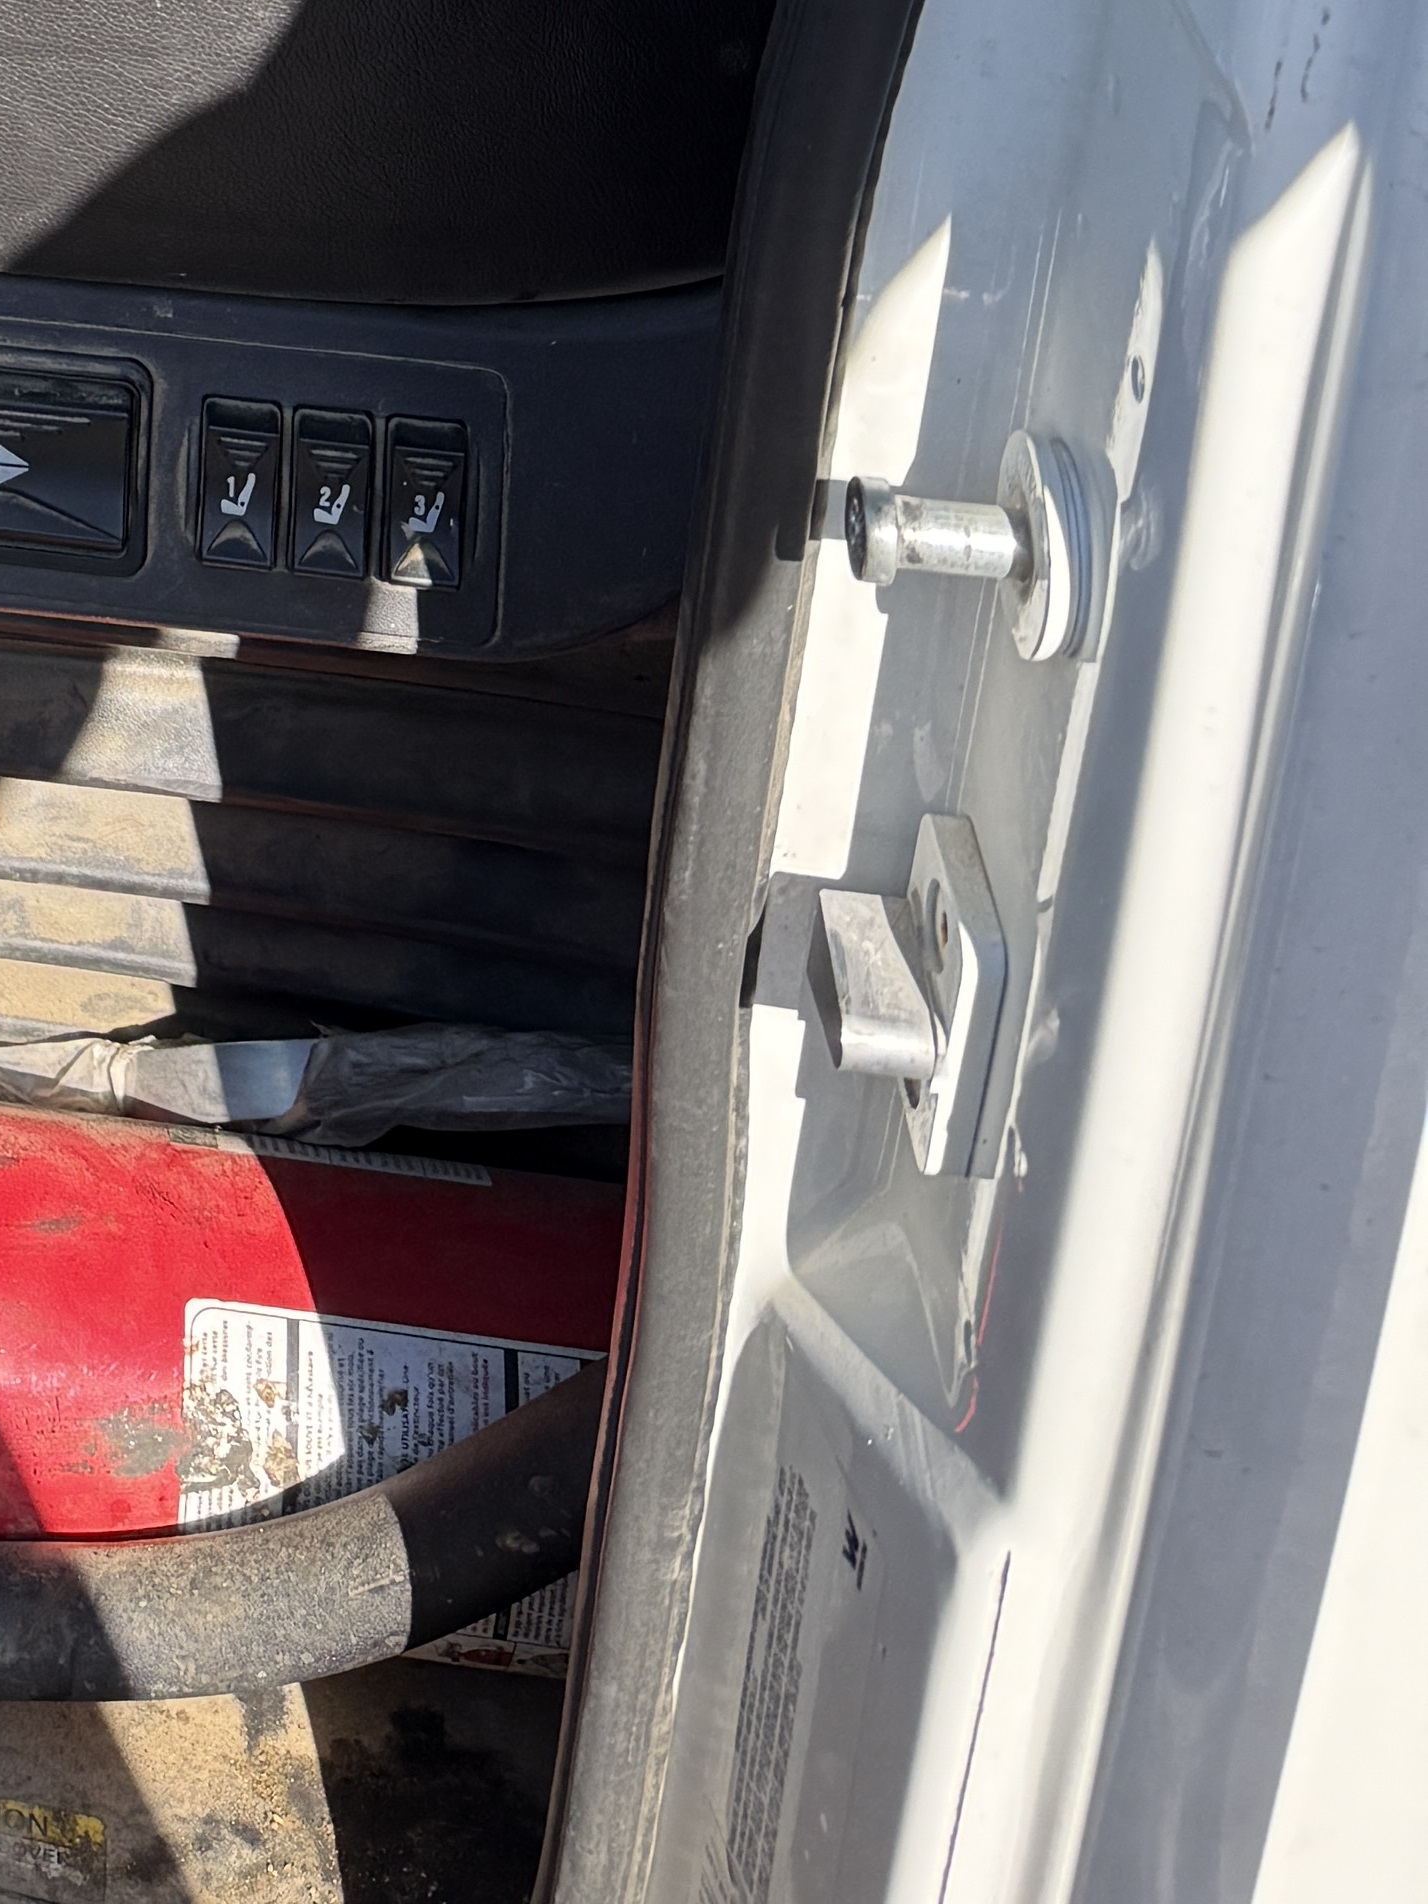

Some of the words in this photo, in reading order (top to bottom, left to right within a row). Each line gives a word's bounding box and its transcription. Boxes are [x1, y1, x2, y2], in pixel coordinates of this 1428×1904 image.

[227, 476, 236, 498] 1
[319, 486, 332, 507] 2
[413, 494, 426, 516] 3
